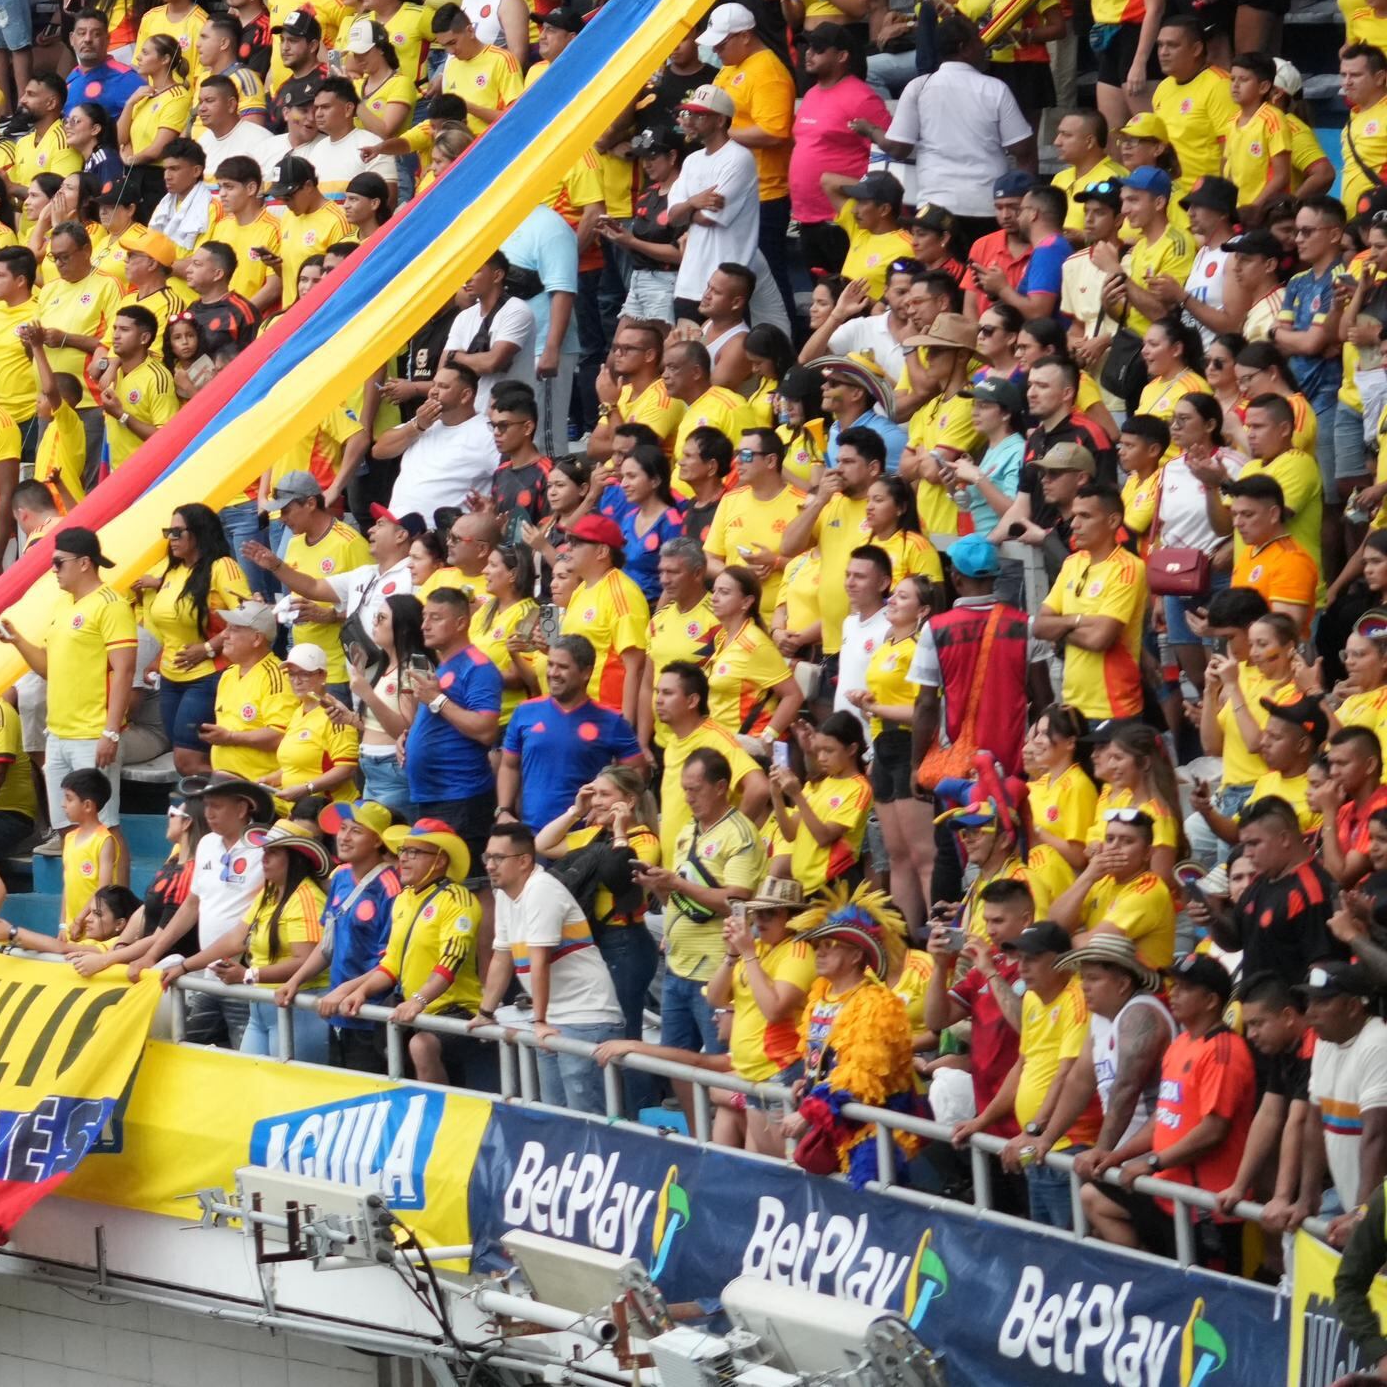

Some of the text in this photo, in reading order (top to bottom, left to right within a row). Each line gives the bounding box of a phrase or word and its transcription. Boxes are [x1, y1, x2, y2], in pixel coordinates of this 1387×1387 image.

[503, 1140, 657, 1261] BetPlay
[741, 1194, 917, 1311] BetPlay
[997, 1264, 1183, 1387] BetPlay
